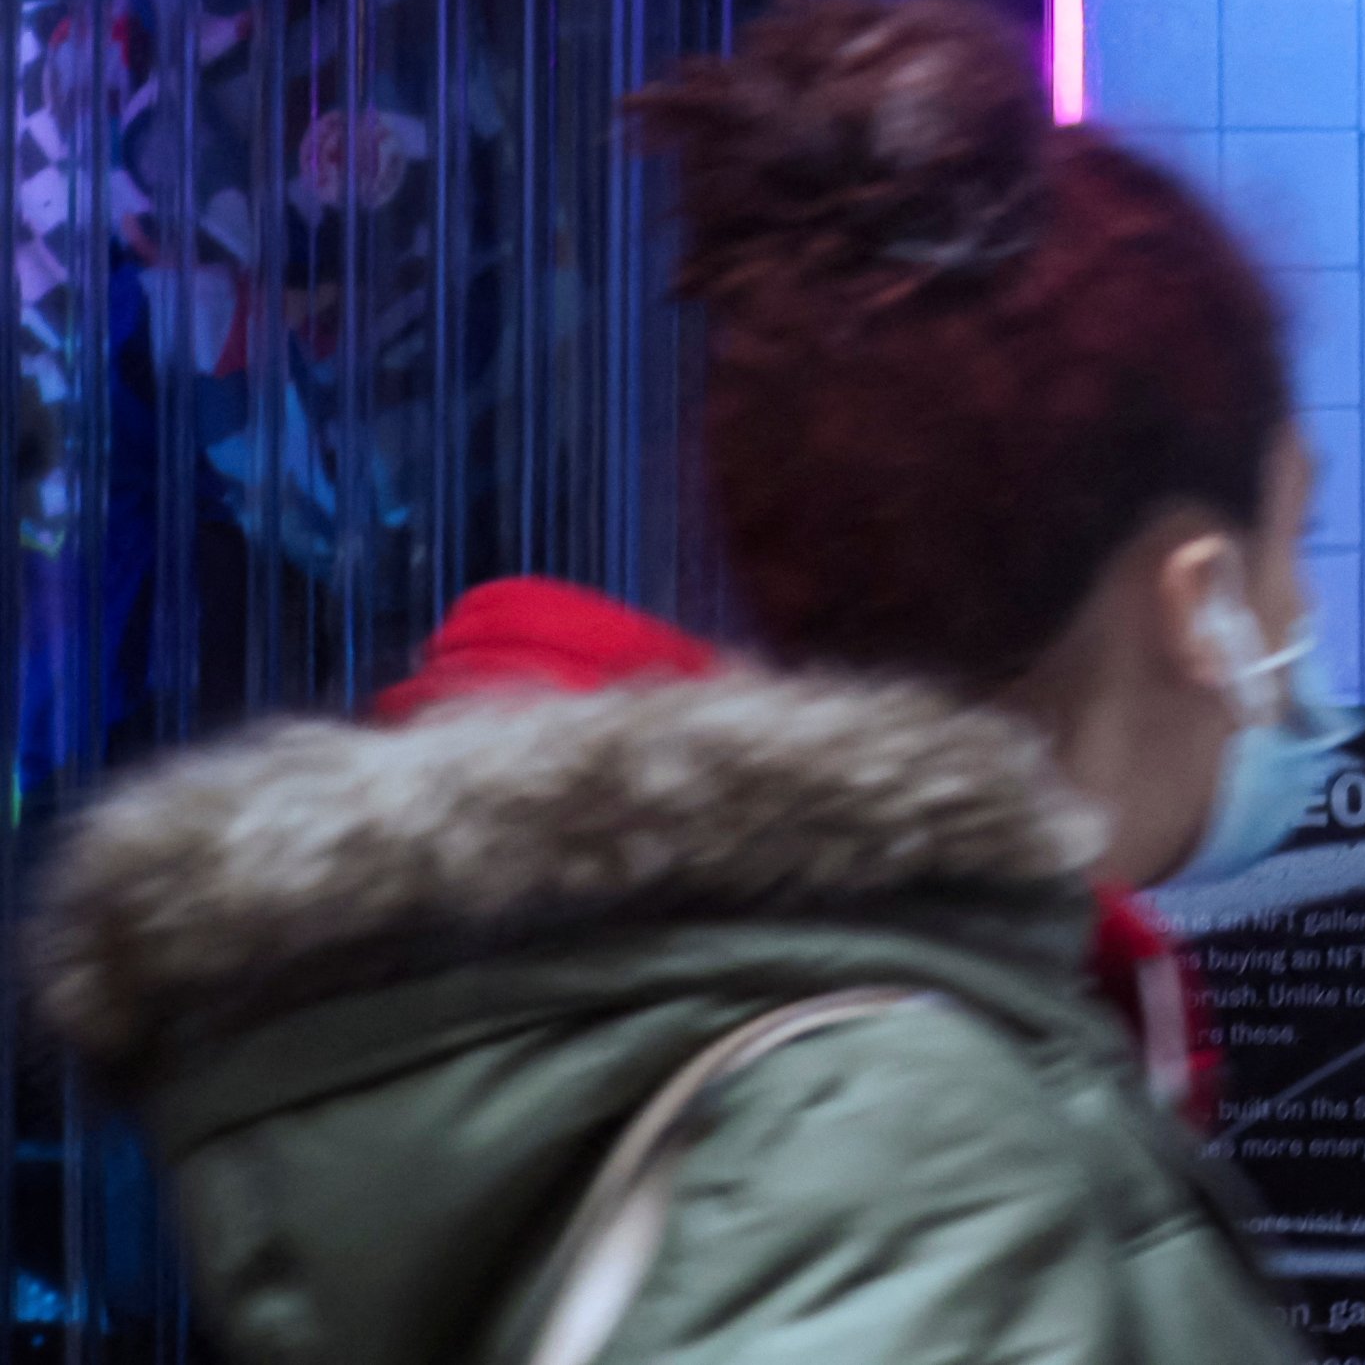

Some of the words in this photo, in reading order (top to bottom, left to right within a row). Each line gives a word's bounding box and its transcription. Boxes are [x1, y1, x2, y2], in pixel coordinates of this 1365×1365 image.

[1208, 947, 1286, 976] buying
[1292, 949, 1321, 970] an
[1268, 984, 1342, 1008] Unlike
[1229, 1022, 1299, 1046] these.
[1219, 1098, 1270, 1121] built
[1275, 1099, 1306, 1121] on
[1311, 1097, 1349, 1121] the
[1241, 1137, 1304, 1158] more
